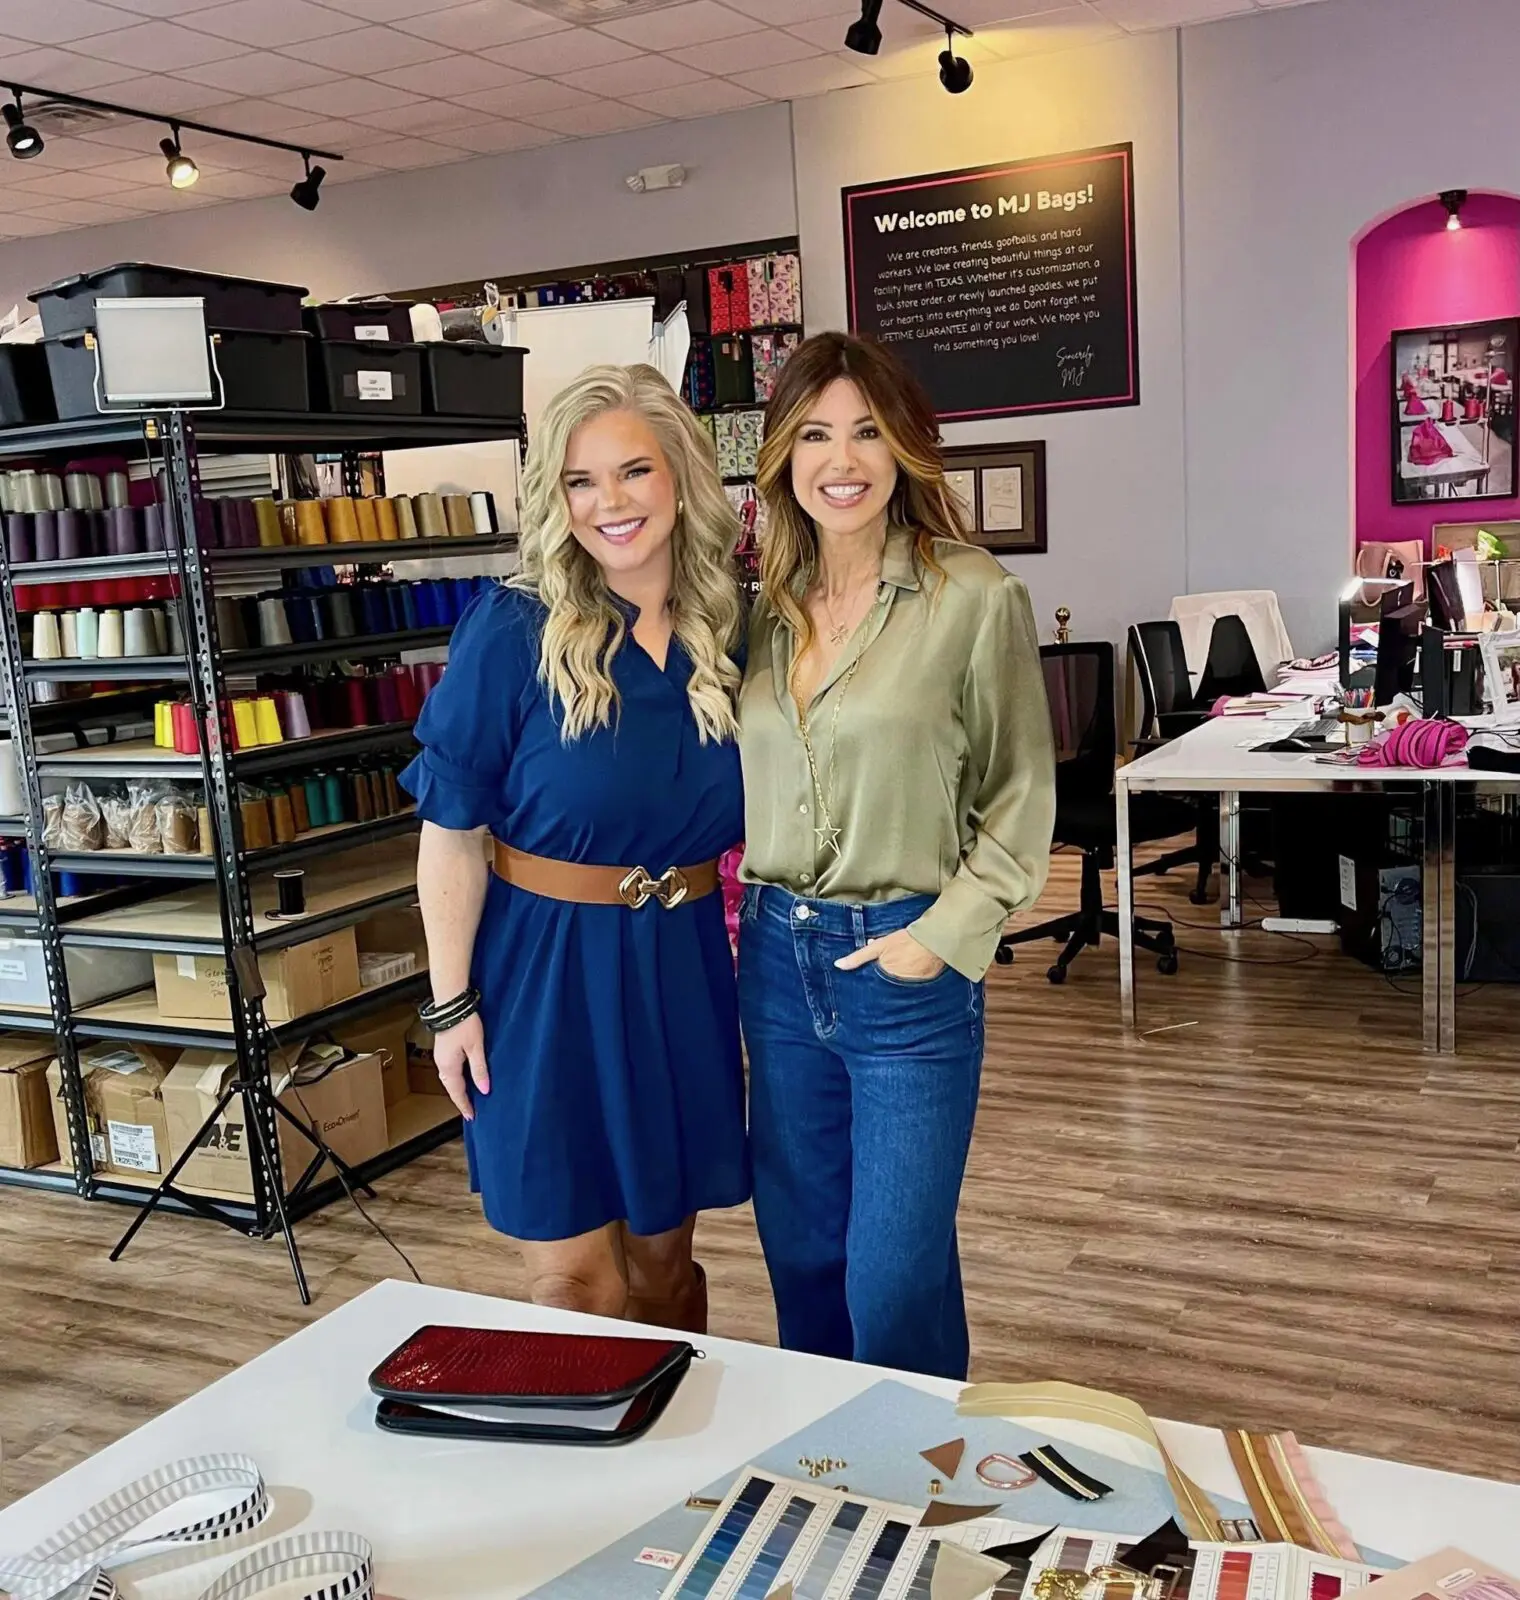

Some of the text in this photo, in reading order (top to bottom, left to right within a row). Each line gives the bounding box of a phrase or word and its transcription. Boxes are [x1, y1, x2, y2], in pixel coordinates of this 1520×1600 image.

[874, 184, 1094, 233] Welcome to MJ Bags!
[887, 253, 903, 261] We
[906, 251, 920, 260] are
[1040, 230, 1057, 240] and
[1060, 227, 1081, 238] hard
[915, 264, 931, 274] We
[934, 262, 950, 272] love
[953, 258, 988, 269] creating
[991, 251, 1030, 264] beautiful
[1034, 246, 1062, 260] things
[1065, 245, 1075, 254] at
[1078, 244, 1093, 252] our
[874, 285, 901, 297] facility
[904, 282, 922, 292] here
[925, 280, 933, 289] in
[967, 271, 1007, 283] Whether
[1010, 269, 1023, 278] it's
[1094, 260, 1100, 268] a
[876, 302, 894, 312] bulk
[897, 299, 918, 309] store
[947, 294, 956, 303] or
[959, 289, 985, 302] newly
[988, 284, 1026, 297] launched
[1066, 279, 1079, 287] we
[1082, 276, 1098, 290] put
[877, 330, 914, 343] LIFETIME
[916, 324, 968, 338] GUARANTEE
[970, 322, 980, 332] all
[984, 322, 993, 330] of
[996, 320, 1010, 329] our
[1039, 315, 1056, 323] We
[1060, 312, 1080, 324] hope
[1084, 310, 1100, 323] you
[880, 318, 893, 327] our
[897, 313, 924, 325] hearts
[926, 312, 943, 320] into
[945, 306, 991, 319] everything
[994, 305, 1007, 313] we
[1082, 294, 1096, 302] we
[933, 332, 1040, 352] find something you love!
